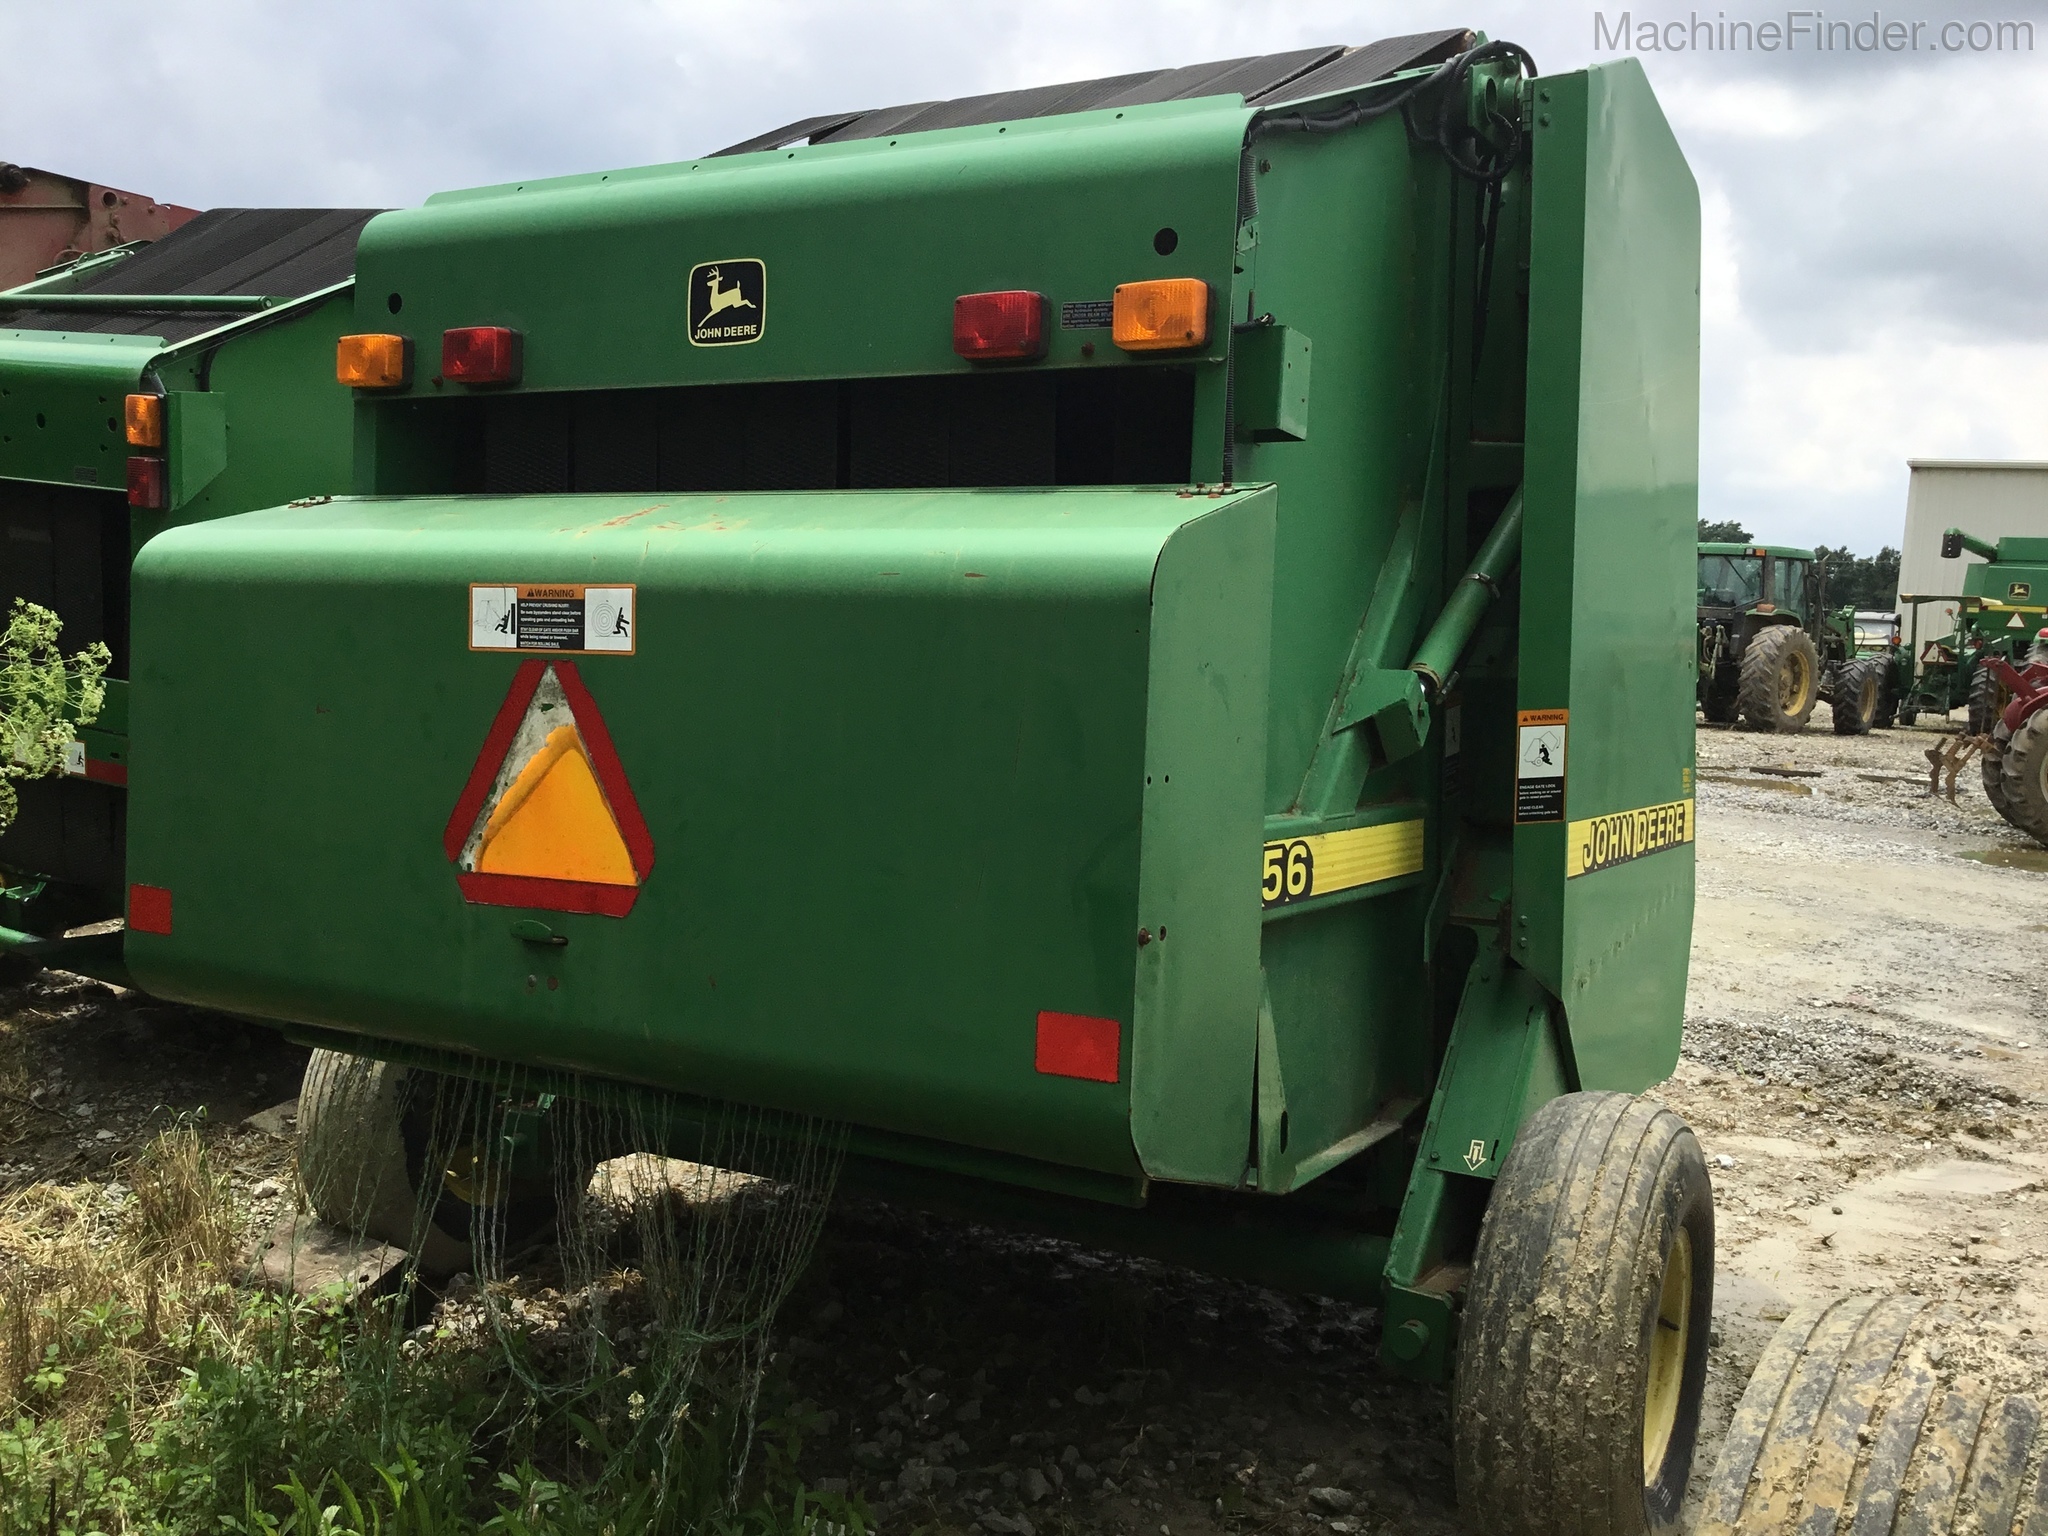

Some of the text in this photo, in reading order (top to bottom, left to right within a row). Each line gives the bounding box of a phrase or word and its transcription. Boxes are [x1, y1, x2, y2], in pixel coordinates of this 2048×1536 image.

[694, 324, 757, 340] JOHN DEERE
[534, 589, 575, 598] WARNING
[1530, 713, 1564, 721] WARNING
[1583, 803, 1684, 869] JOHN DEERE
[1262, 843, 1308, 902] 56
